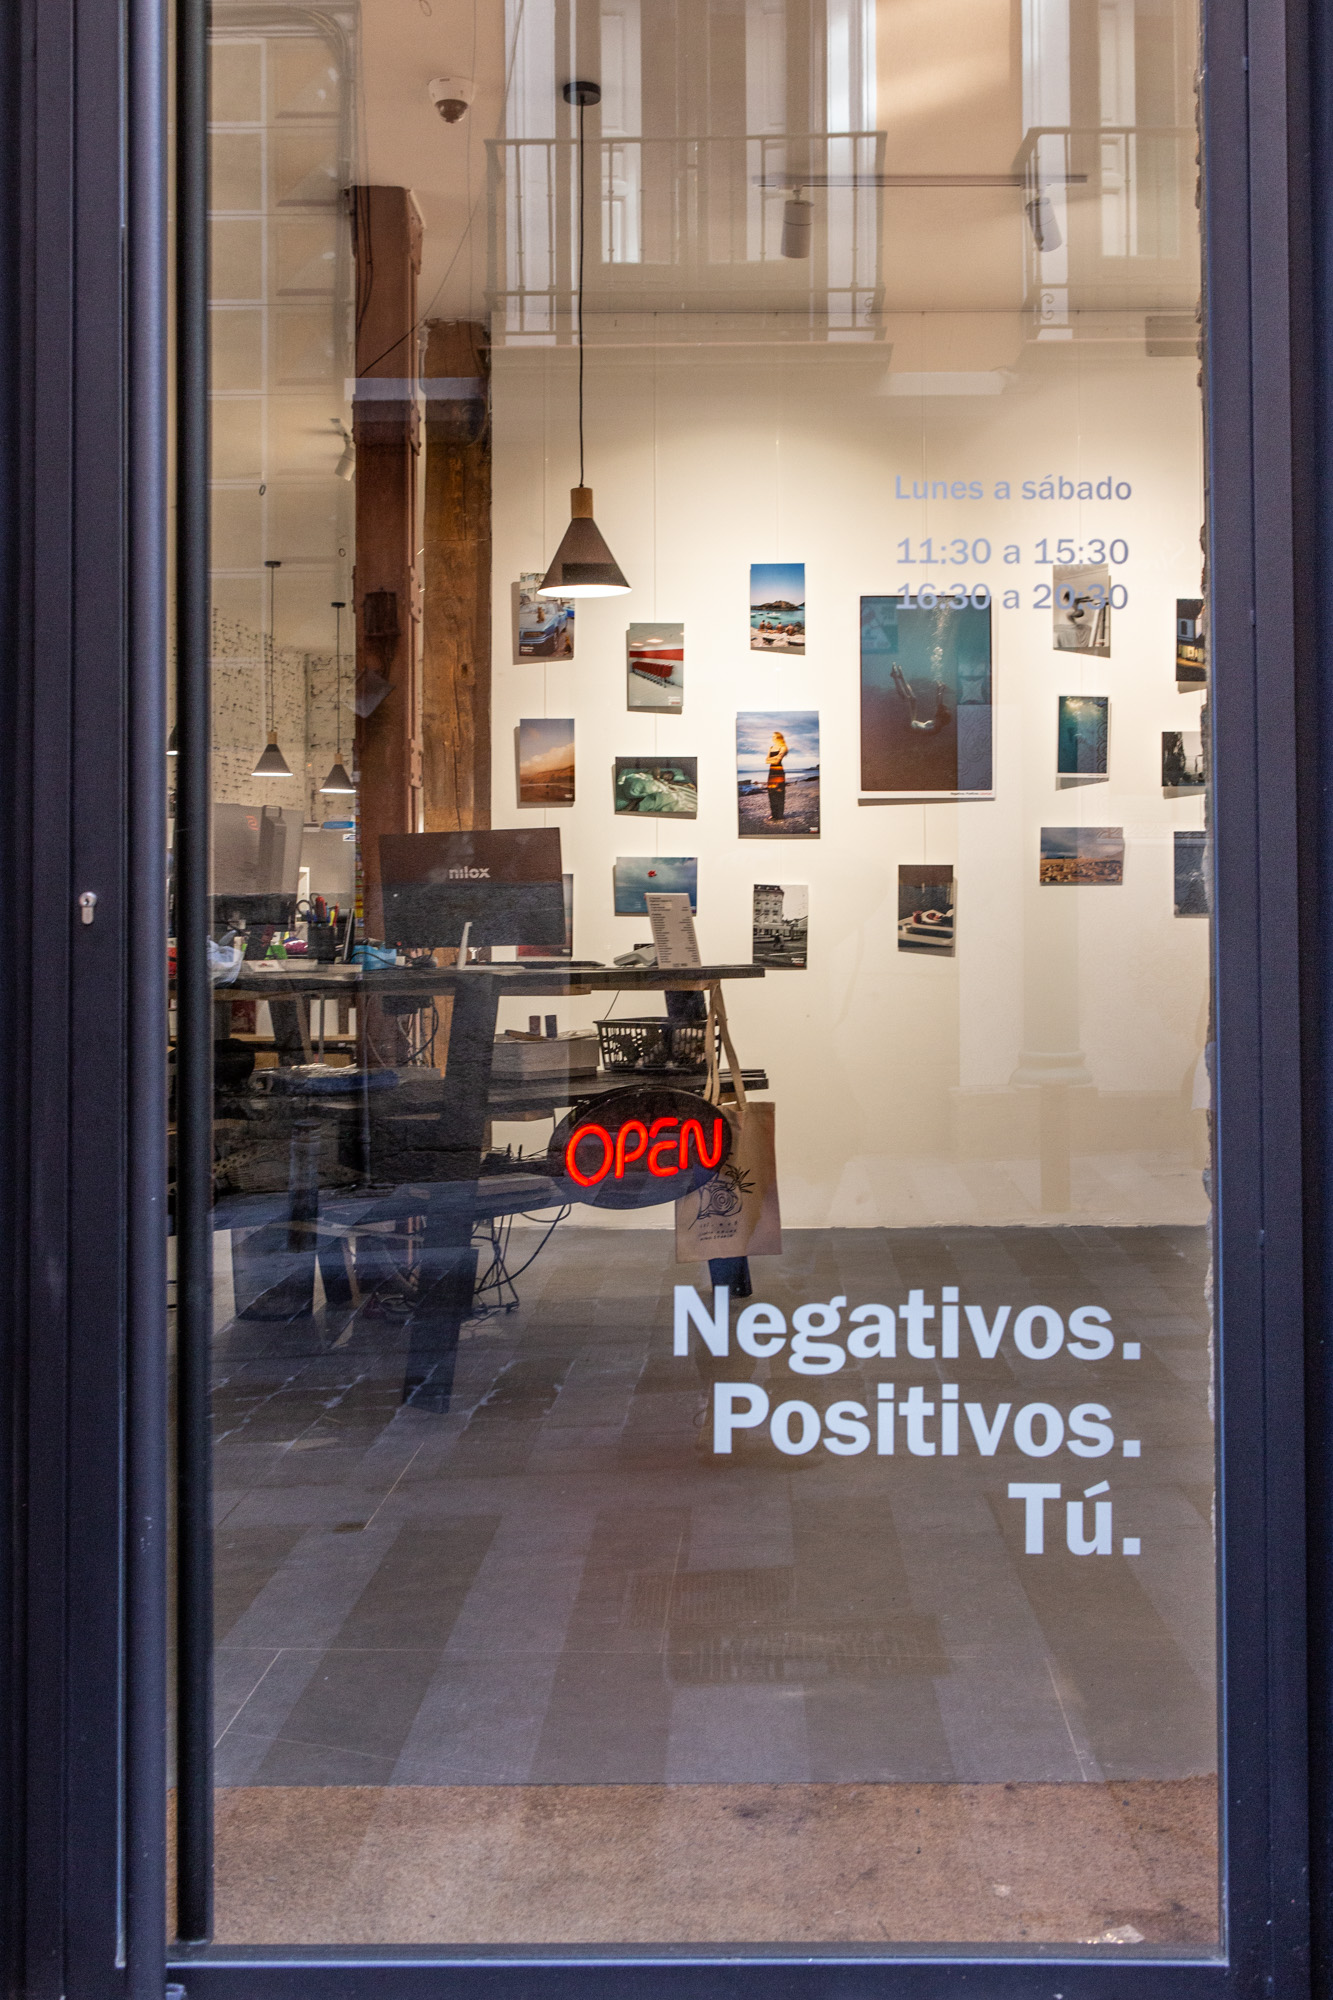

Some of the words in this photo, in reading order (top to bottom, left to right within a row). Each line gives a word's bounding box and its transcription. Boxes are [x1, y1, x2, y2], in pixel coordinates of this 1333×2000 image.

[895, 474, 984, 500] Lunes
[994, 481, 1011, 500] a
[1022, 474, 1132, 500] sábado
[896, 538, 992, 565] 11:30
[1003, 544, 1021, 564] a
[1034, 538, 1129, 565] 15:30
[895, 583, 992, 610] 16:30
[1002, 589, 1020, 609] a
[1033, 584, 1129, 610] 20:30
[449, 866, 491, 880] nilox
[565, 1117, 723, 1188] OPEN
[673, 1285, 1141, 1375] Negativos.
[713, 1382, 1141, 1458] Positivos.
[1007, 1480, 1141, 1556] Tú.
